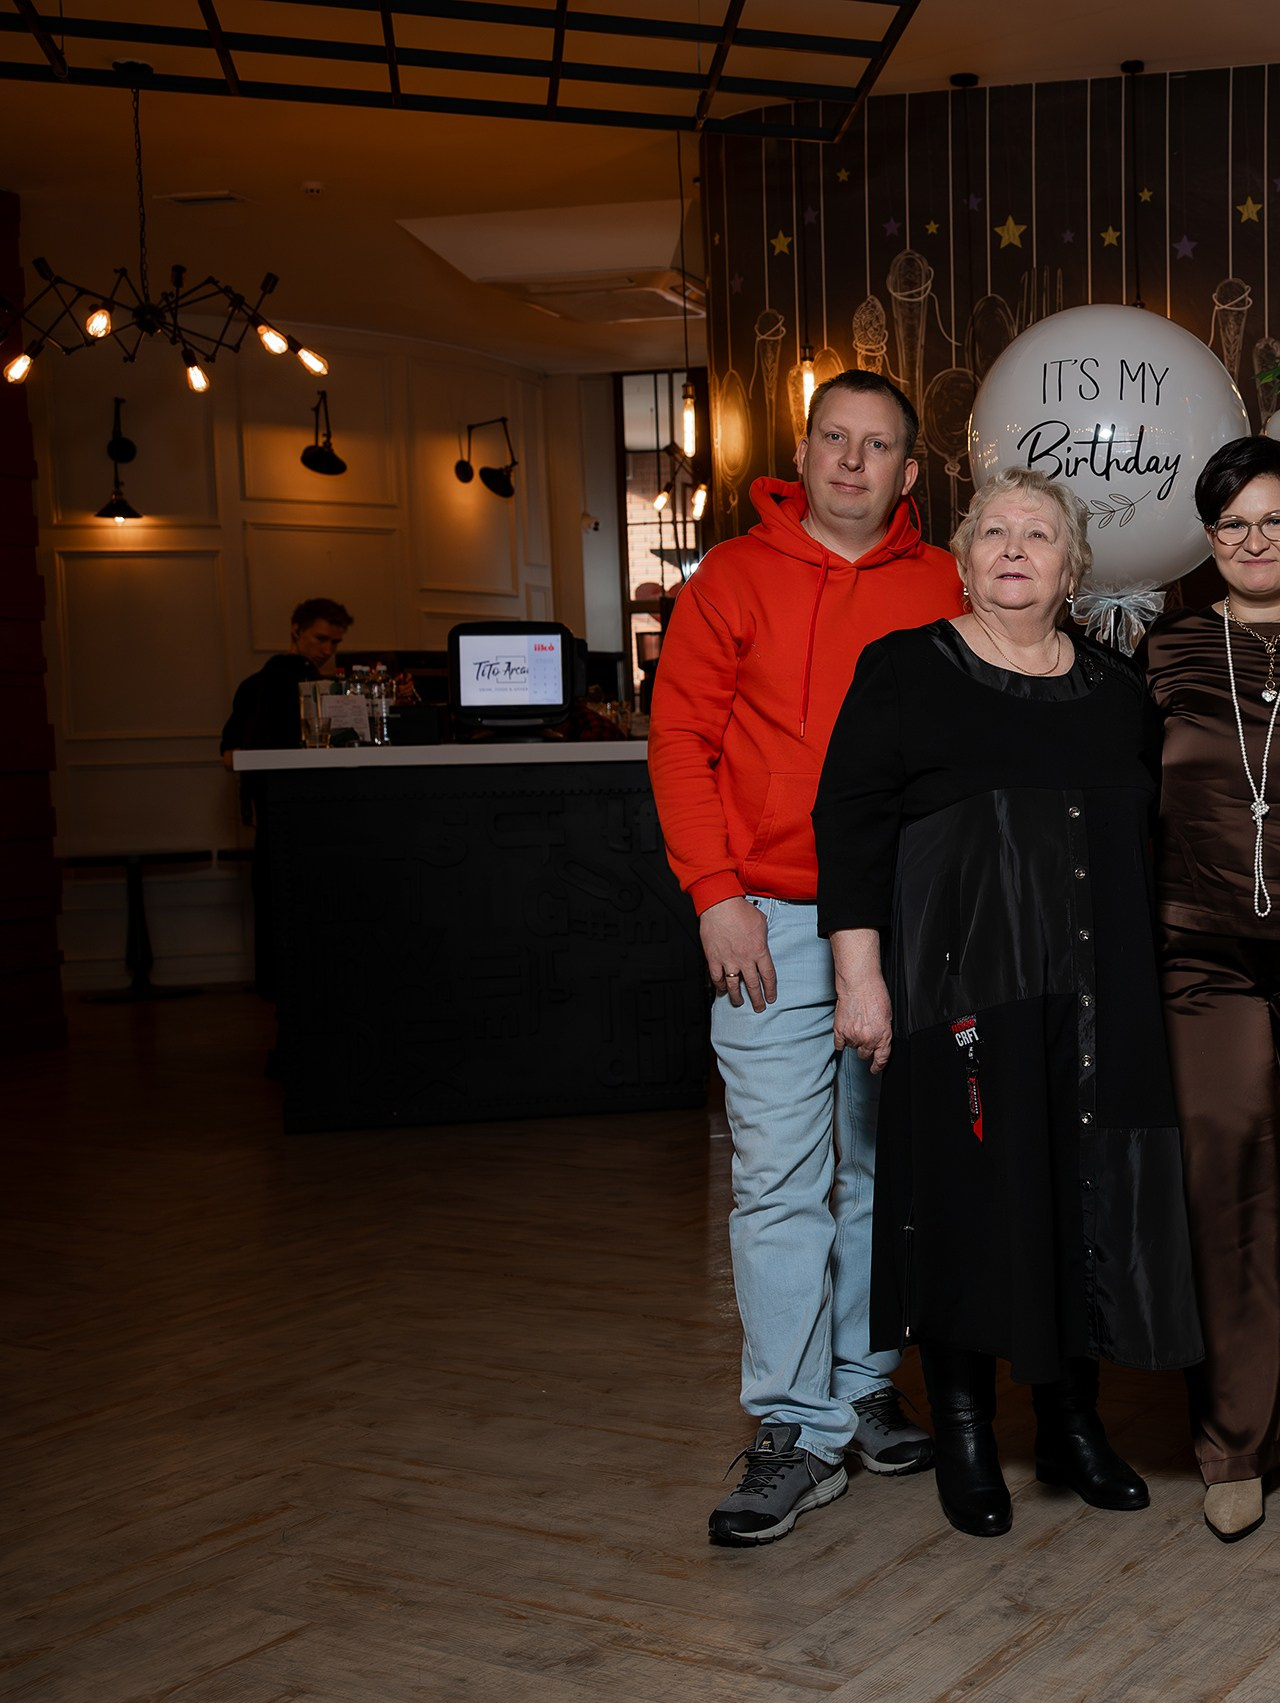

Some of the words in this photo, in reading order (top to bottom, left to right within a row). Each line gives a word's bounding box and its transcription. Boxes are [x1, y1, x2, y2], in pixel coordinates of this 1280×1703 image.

[1041, 357, 1101, 405] IT'S
[1118, 359, 1170, 406] MY
[1016, 420, 1182, 501] Birthday
[954, 1026, 980, 1048] CRFT
